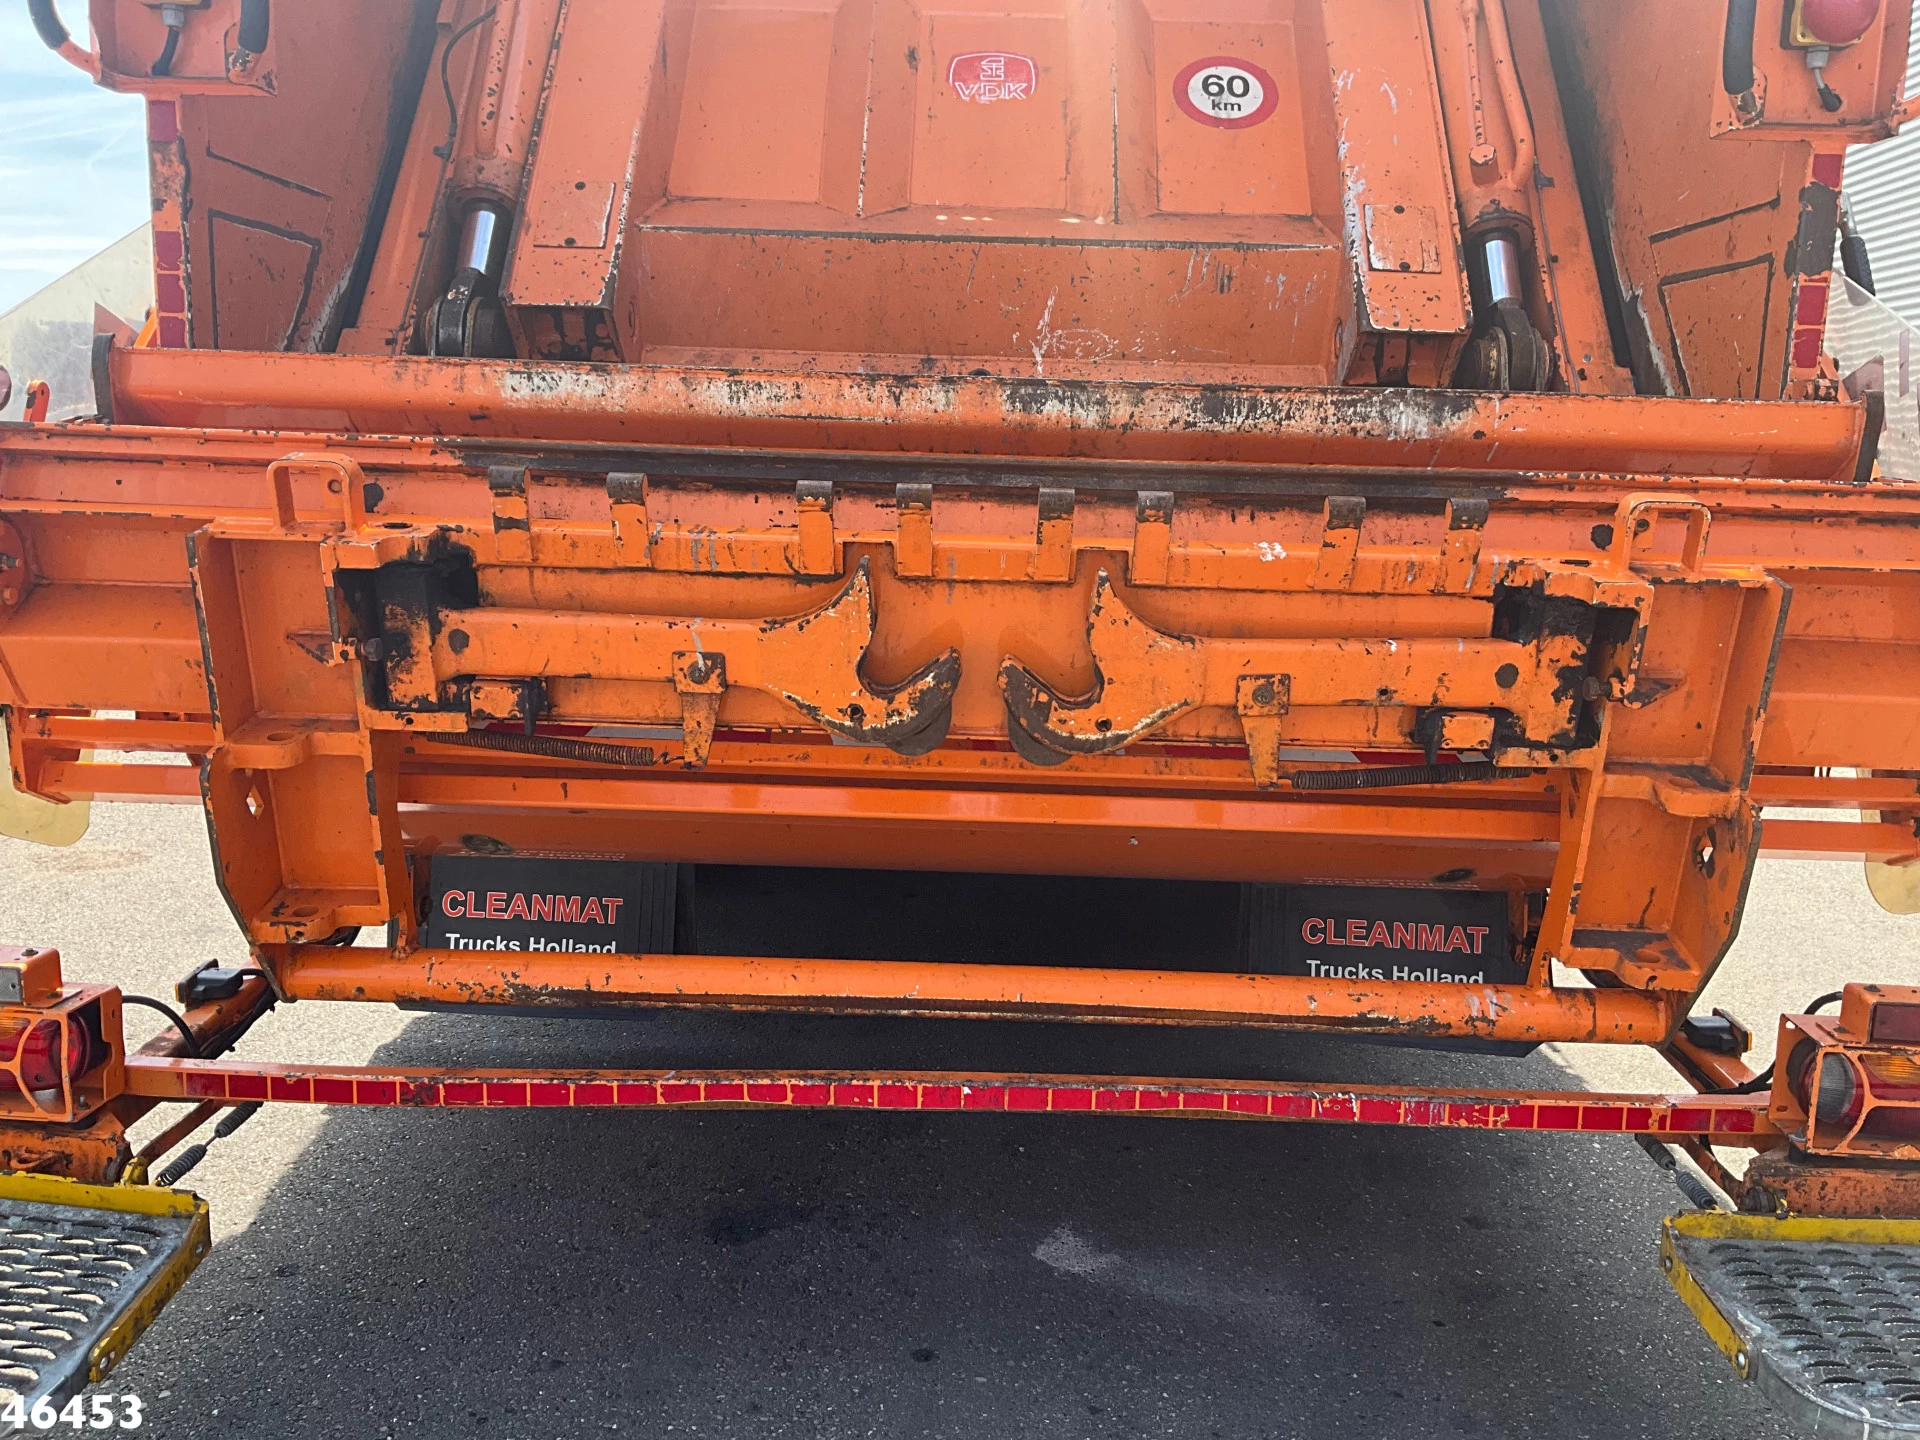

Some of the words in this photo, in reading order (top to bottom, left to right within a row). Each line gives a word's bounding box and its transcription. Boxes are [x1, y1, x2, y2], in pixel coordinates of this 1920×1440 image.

[955, 82, 1028, 101] VDK
[1201, 74, 1250, 98] 60
[1211, 99, 1242, 112] km
[442, 889, 623, 925] CLEANMAT
[445, 933, 521, 952] Trucks
[528, 936, 617, 954] Holland
[1302, 917, 1489, 954] CLEANMAT
[1306, 959, 1385, 981] Trucks
[1392, 965, 1484, 984] Holland
